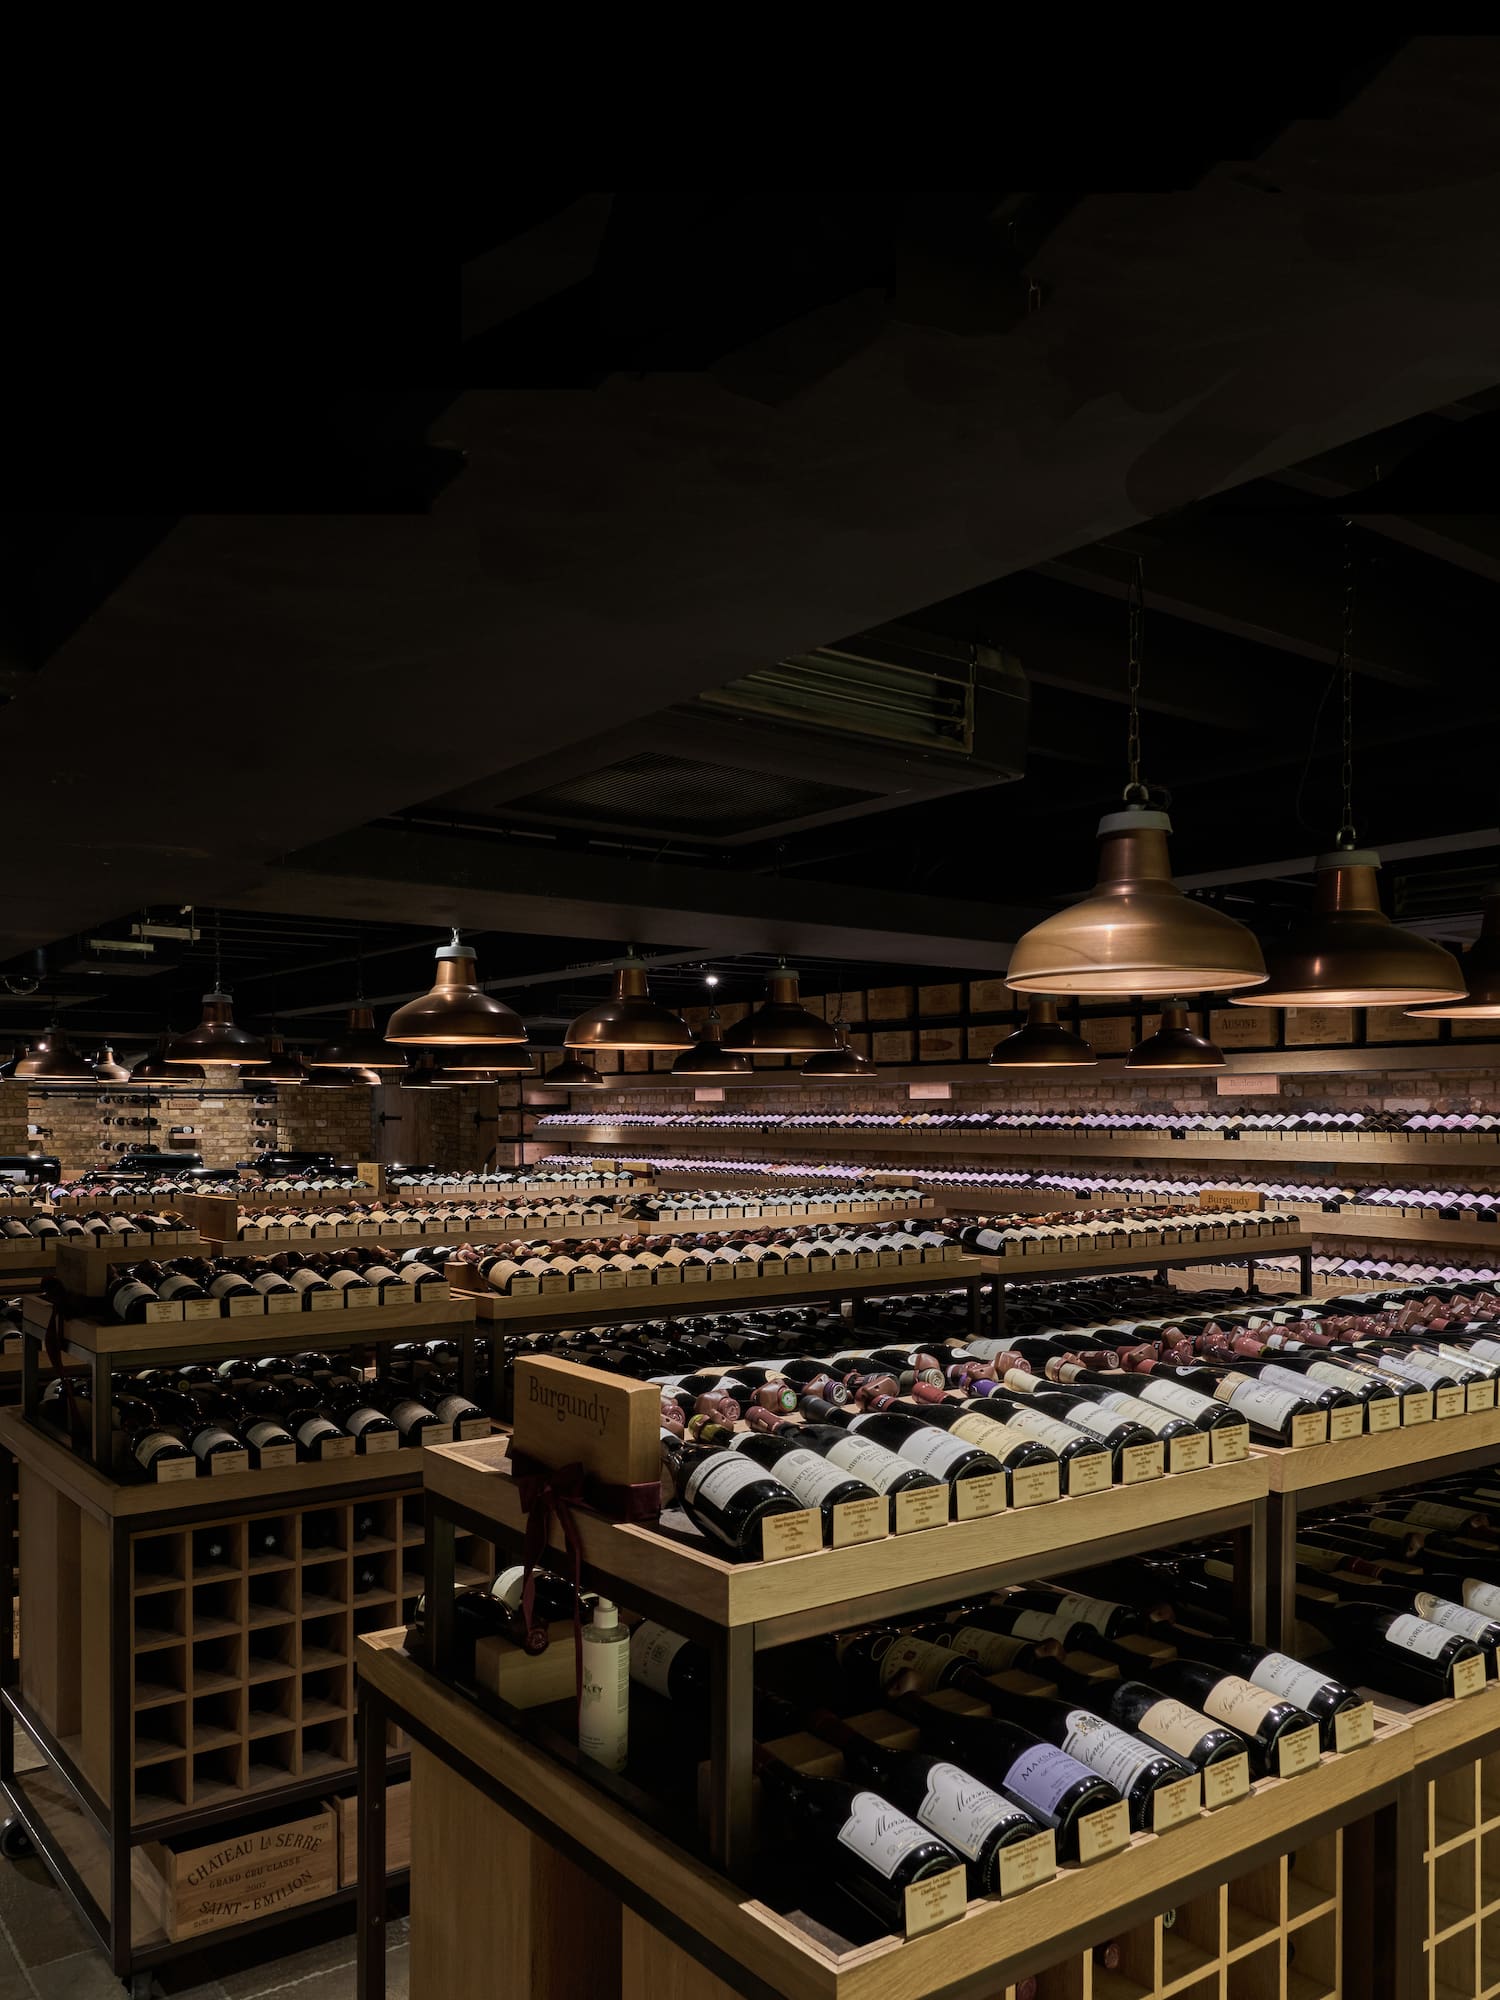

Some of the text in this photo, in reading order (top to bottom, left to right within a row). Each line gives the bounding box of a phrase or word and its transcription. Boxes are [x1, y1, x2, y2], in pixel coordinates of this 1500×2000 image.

[1221, 1017, 1258, 1031] AUSONE
[1207, 1194, 1250, 1208] Burgundy
[528, 1375, 610, 1436] Burgundy
[187, 1838, 254, 1888] CHATEAU
[275, 1832, 323, 1852] SERRE
[208, 1872, 242, 1890] GRAND
[244, 1866, 264, 1880] CRU
